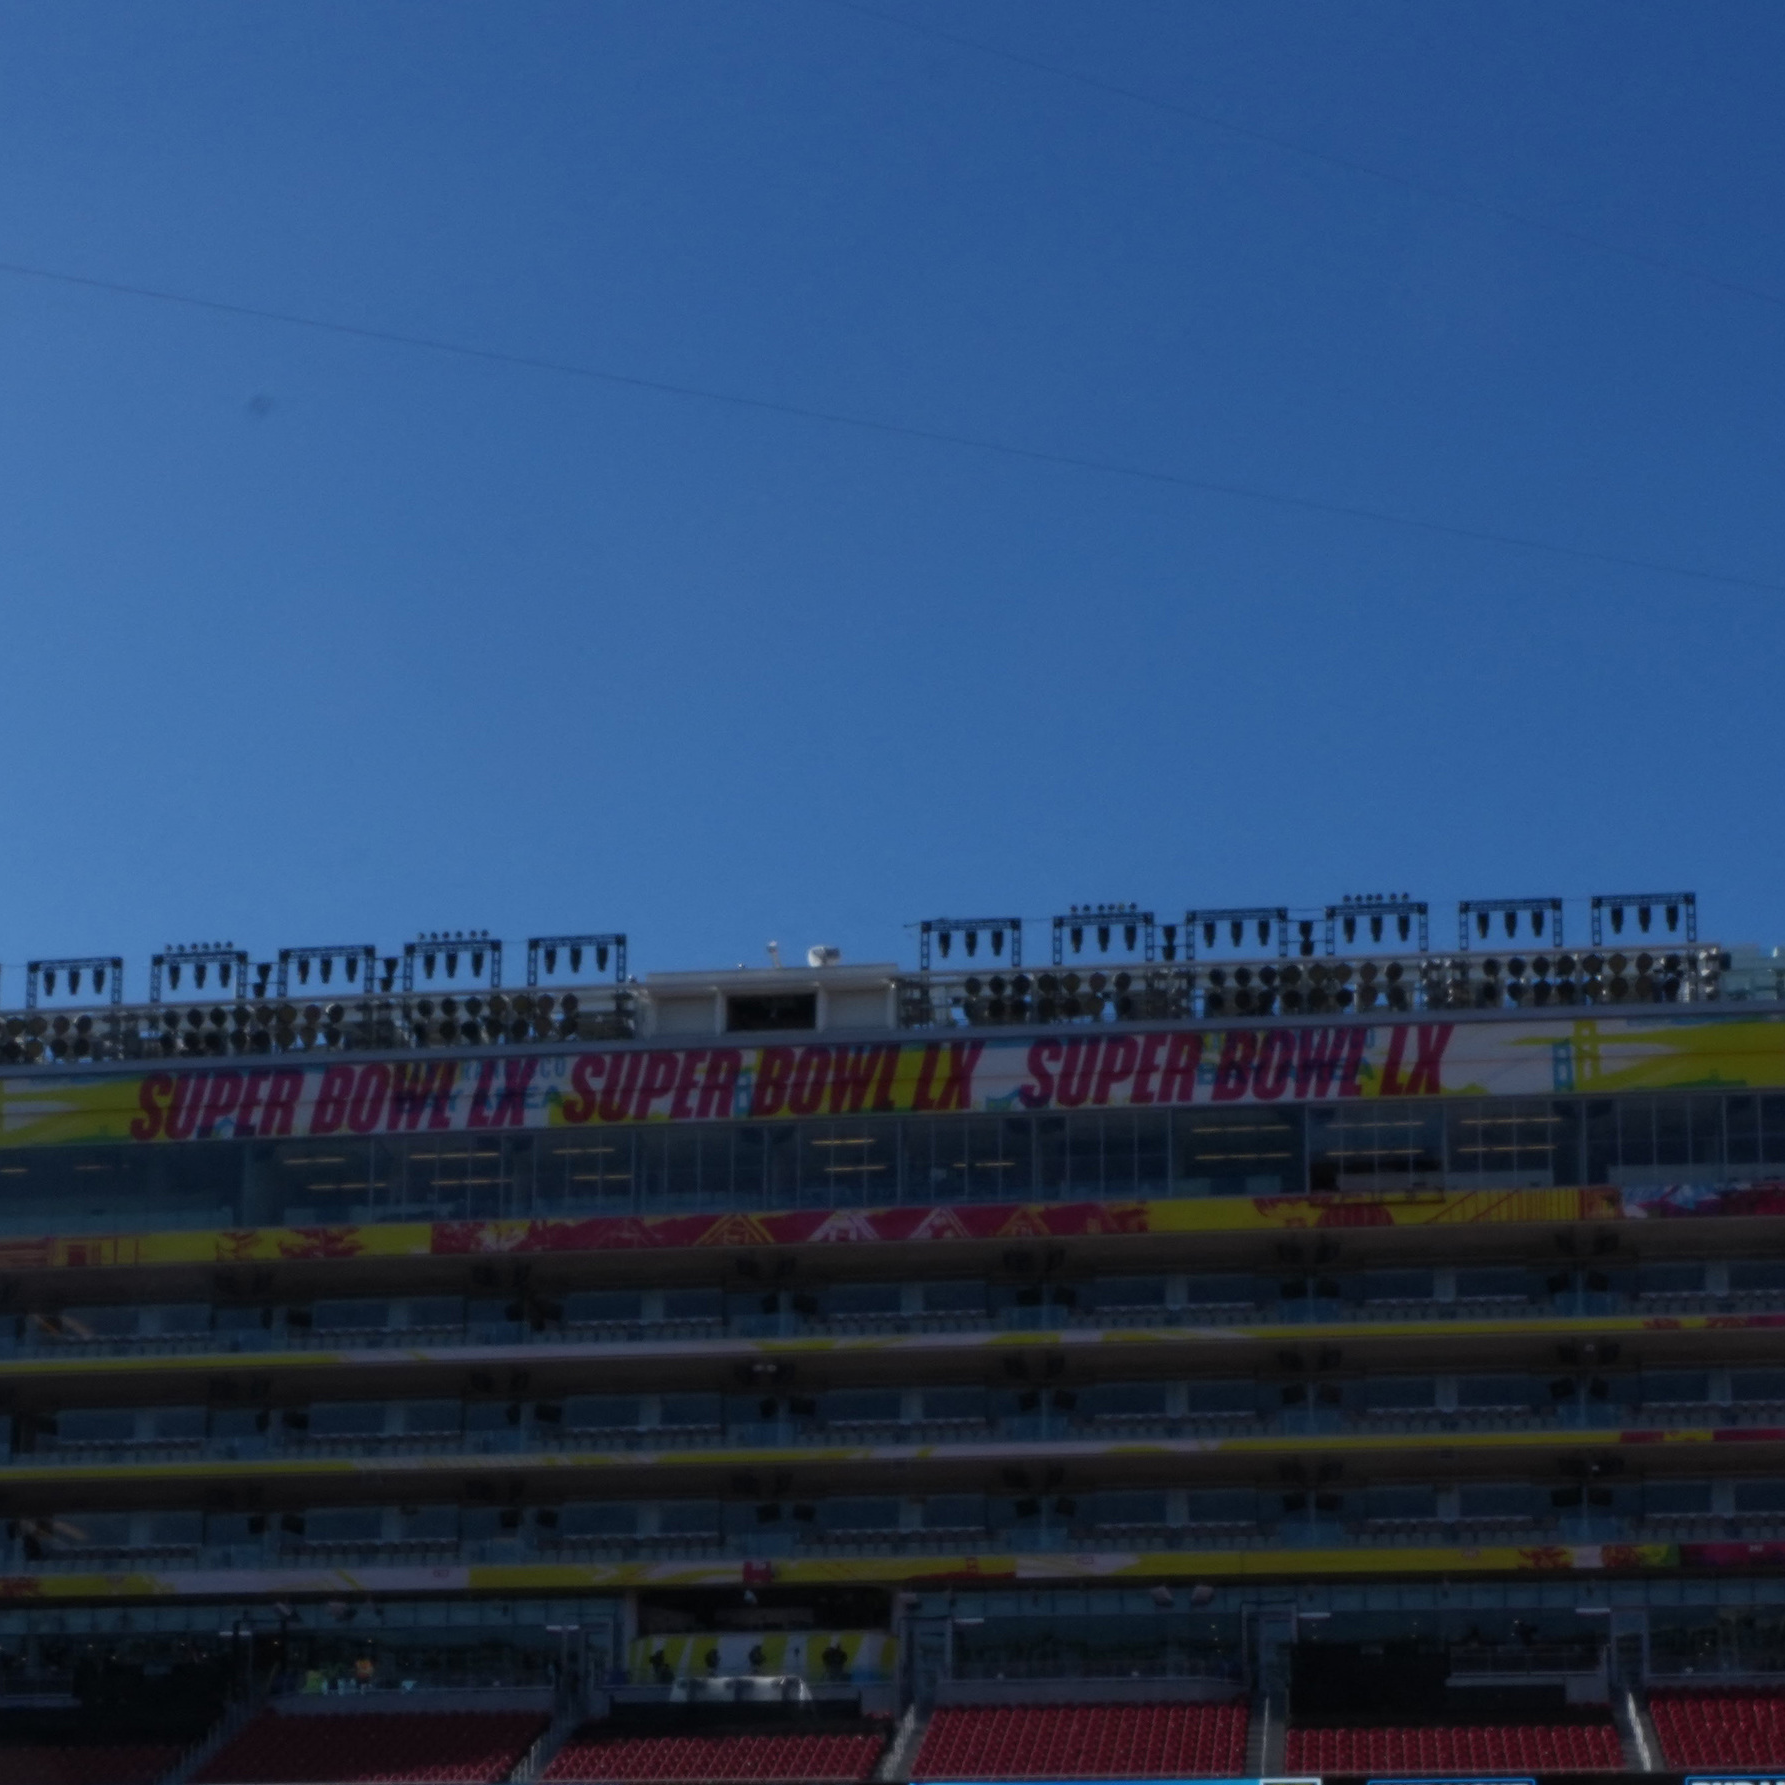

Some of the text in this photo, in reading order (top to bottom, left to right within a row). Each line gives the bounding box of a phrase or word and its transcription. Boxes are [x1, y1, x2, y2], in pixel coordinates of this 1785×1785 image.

[130, 1056, 540, 1142] SUPER BOWL LX
[561, 1038, 987, 1124] SUPER BOWL LX
[1017, 1023, 1456, 1109] SUPER BOWL LX
